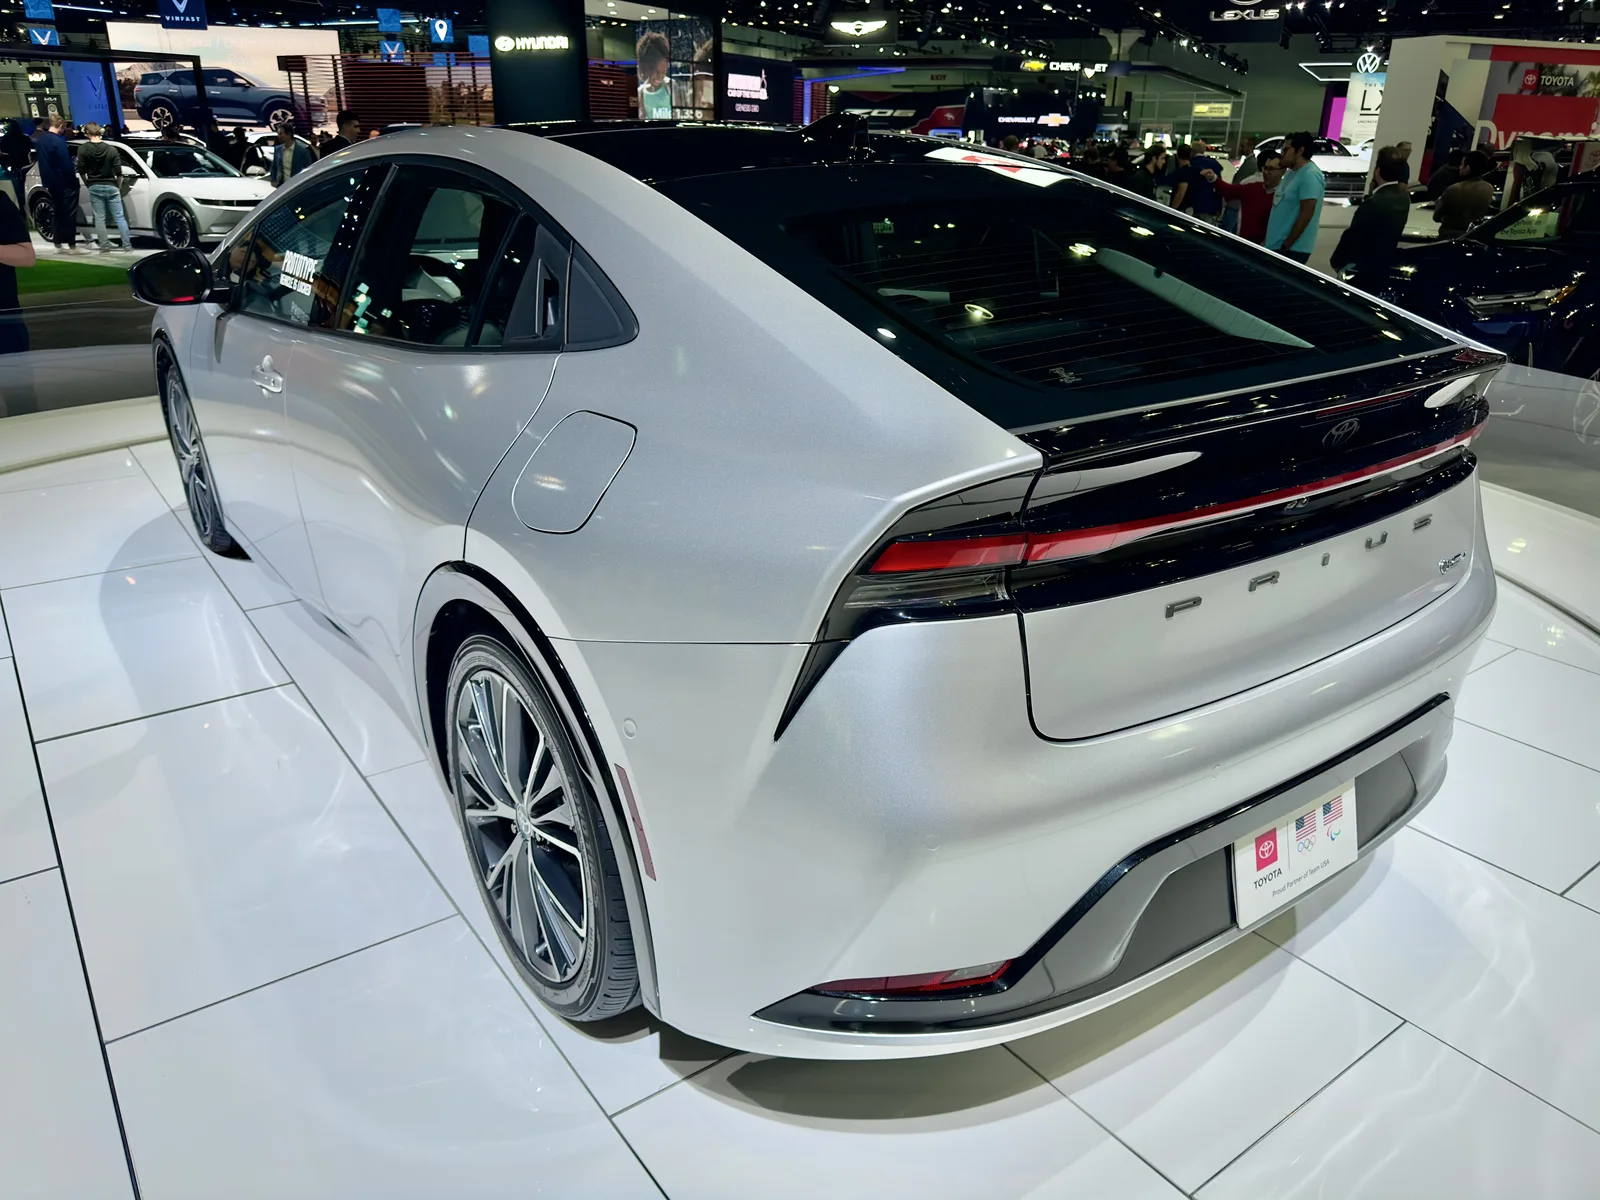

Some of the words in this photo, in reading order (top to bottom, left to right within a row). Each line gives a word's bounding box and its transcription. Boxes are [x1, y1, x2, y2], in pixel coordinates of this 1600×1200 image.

[1209, 9, 1280, 21] LEXUS
[516, 35, 569, 50] HYUNDAI
[1049, 61, 1108, 73] CHEVET
[1540, 75, 1574, 87] TOYOTA
[281, 249, 319, 283] PROTOTYPE
[1165, 513, 1433, 620] PRIUS
[1253, 867, 1283, 889] TOYOTA
[1272, 885, 1287, 897] Proud
[1286, 875, 1303, 889] Partner
[1308, 864, 1320, 875] Team
[1320, 858, 1330, 868] USA
